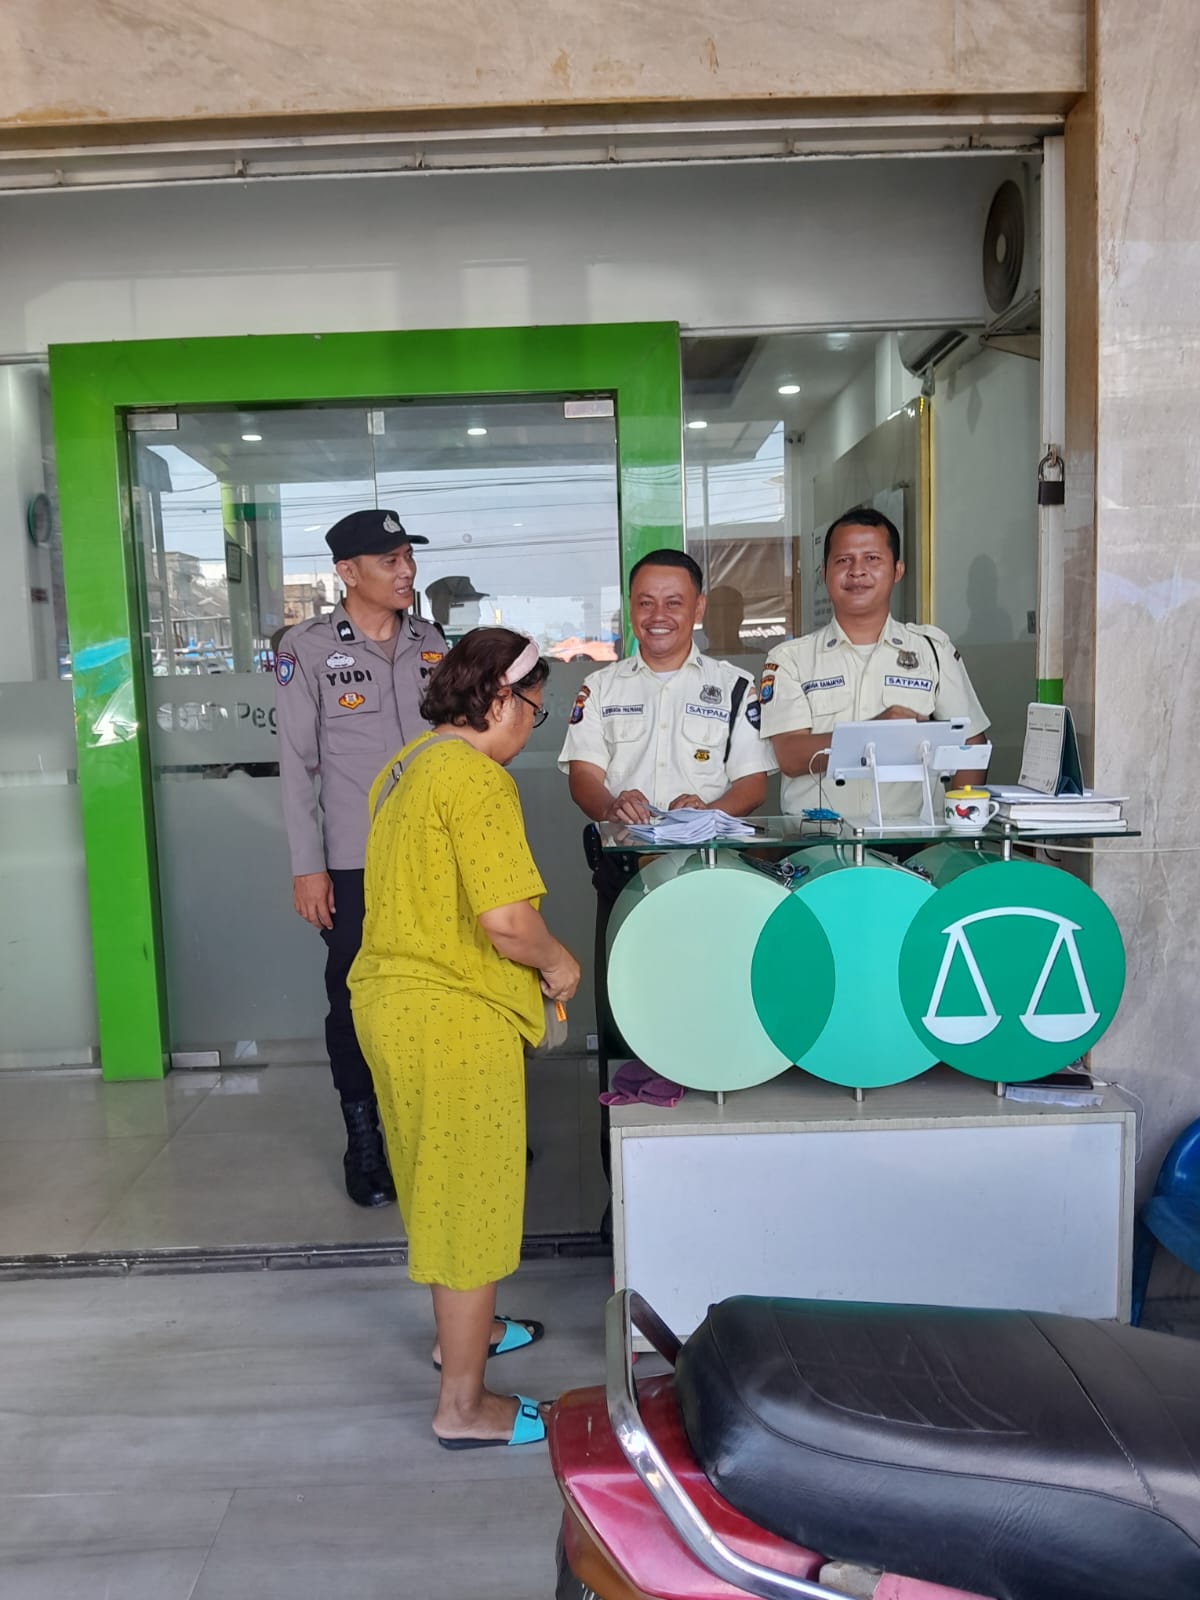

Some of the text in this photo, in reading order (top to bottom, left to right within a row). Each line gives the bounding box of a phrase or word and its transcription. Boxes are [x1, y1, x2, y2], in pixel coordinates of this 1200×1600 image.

[326, 670, 372, 686] YUDI
[888, 677, 929, 688] SATPAM
[689, 706, 728, 718] SATPAM
